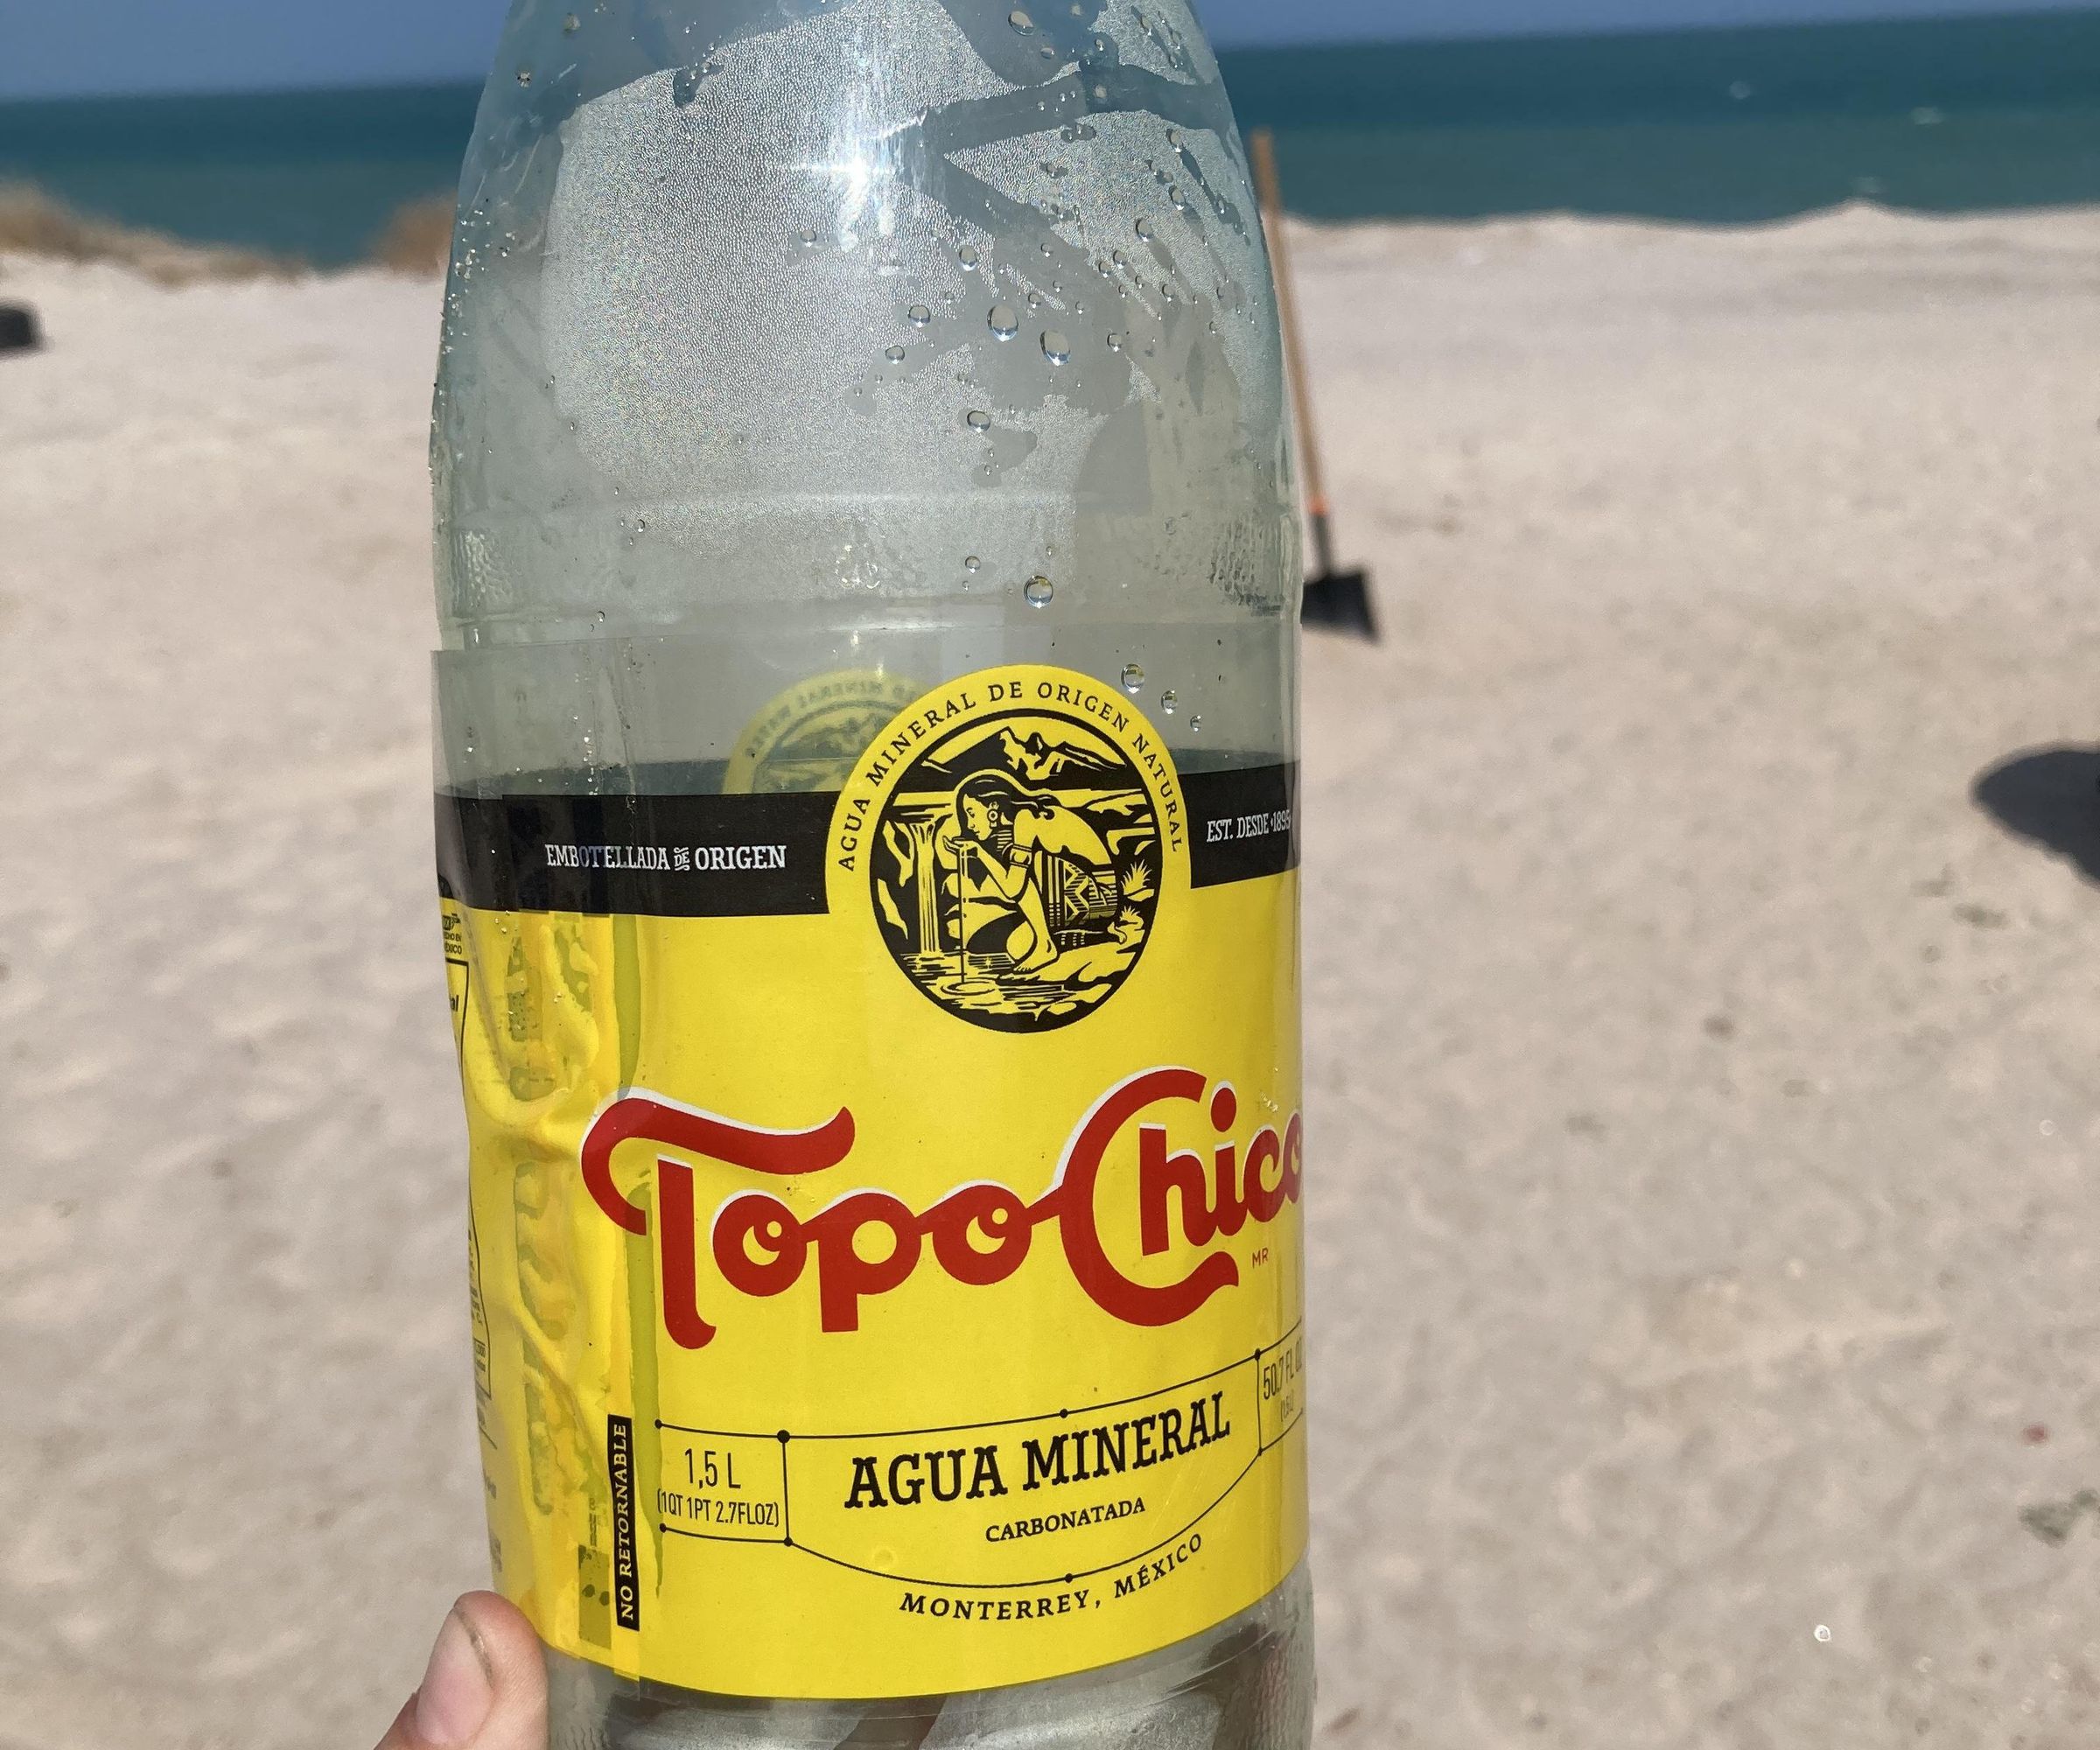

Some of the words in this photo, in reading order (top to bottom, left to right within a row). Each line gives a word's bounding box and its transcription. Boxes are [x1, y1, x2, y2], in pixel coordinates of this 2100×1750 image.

[838, 794, 871, 872] AGUA
[866, 692, 976, 787] MINERAL
[989, 682, 1023, 701] DE
[1037, 682, 1130, 732] ORIGEN
[1132, 733, 1183, 853] NATURAL
[1206, 818, 1234, 843] EST.
[1236, 813, 1270, 839] DESDE
[544, 844, 670, 871] EMBOTELLADA
[695, 845, 787, 871] ORIGEN
[581, 1087, 1031, 1350] Topo
[1031, 1066, 1302, 1326] Chico
[1252, 1247, 1269, 1268] MR
[684, 1447, 718, 1489] 1,5
[727, 1452, 741, 1489] L
[844, 1446, 1008, 1508] AGUA
[1022, 1391, 1230, 1491] MINERAL
[612, 1423, 634, 1578] RETORNABLE
[657, 1488, 683, 1517] (1QT
[686, 1496, 711, 1522] 1PT
[985, 1496, 1146, 1543] CARBONATADA
[899, 1591, 1102, 1621] MONTERREY,
[1114, 1533, 1203, 1599] MÉXICO
[617, 1585, 634, 1620] NO
